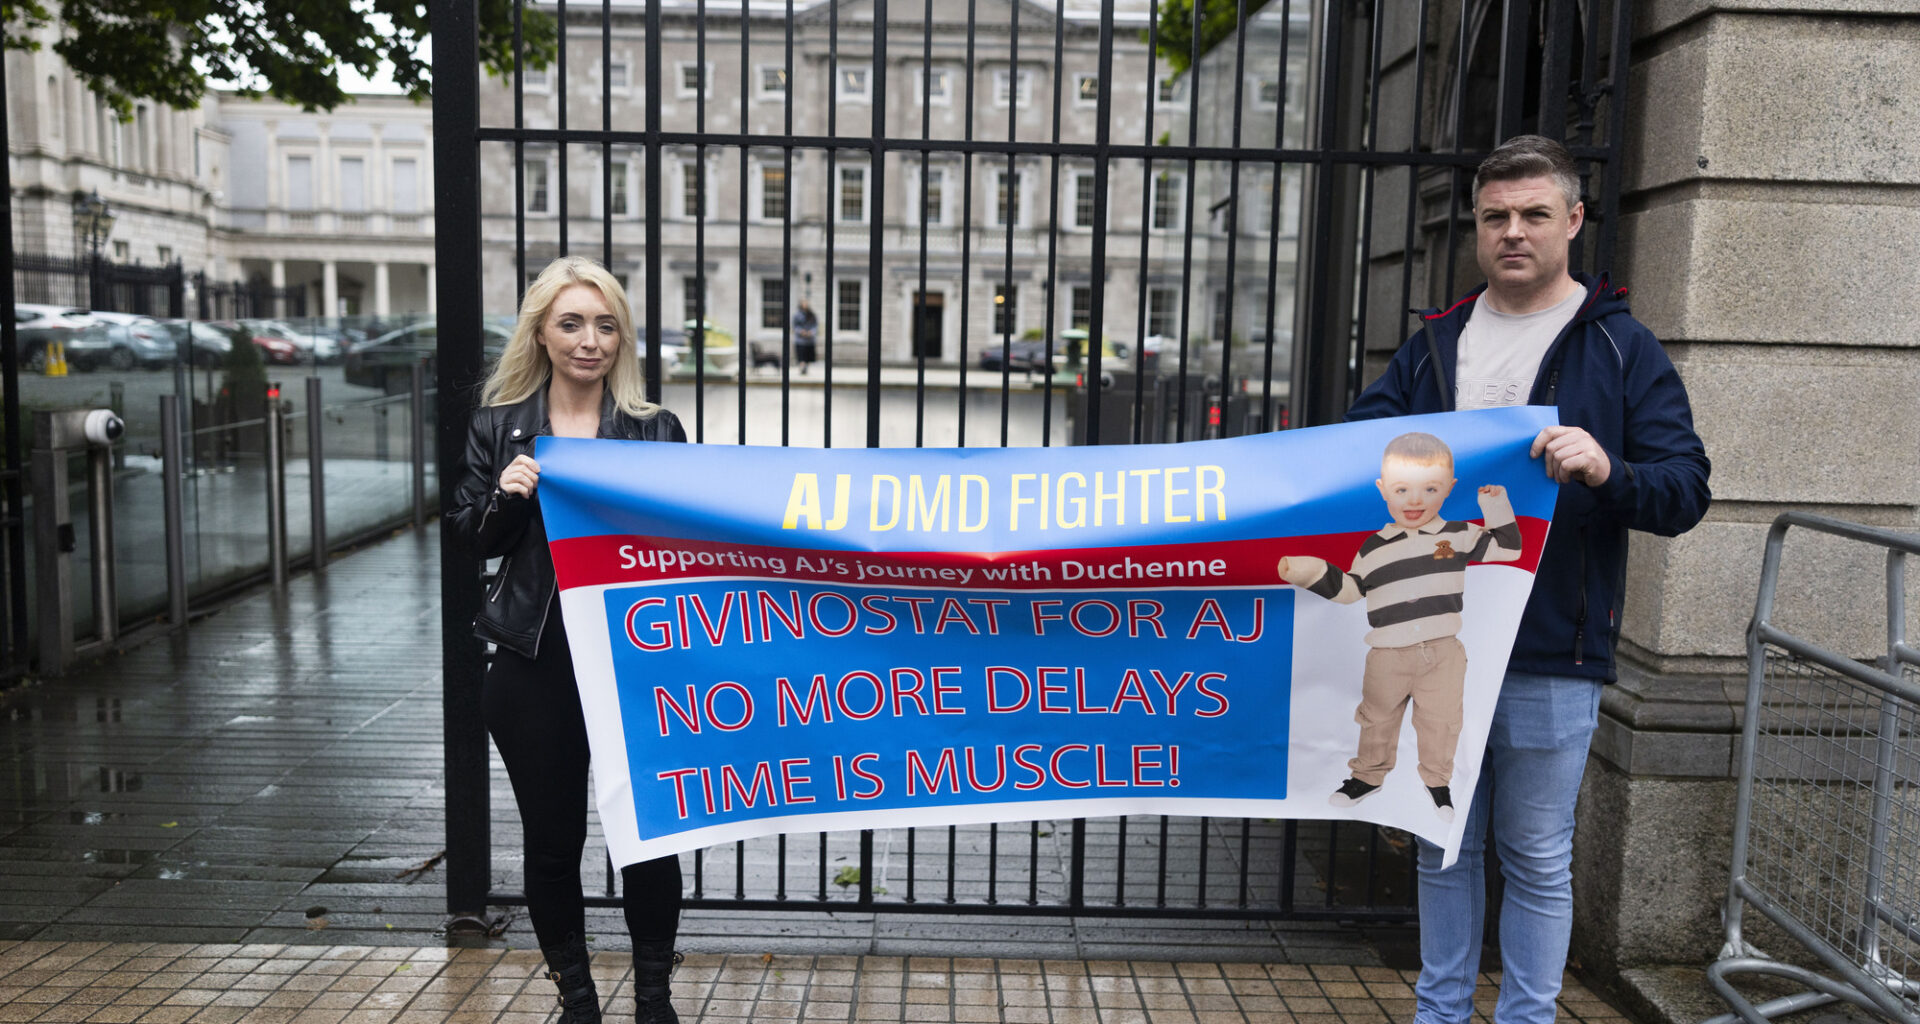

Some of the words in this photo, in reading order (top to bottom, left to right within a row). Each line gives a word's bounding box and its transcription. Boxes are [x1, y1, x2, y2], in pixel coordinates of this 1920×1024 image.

[782, 474, 851, 531] AJ
[870, 475, 989, 532] DMD
[1010, 465, 1227, 530] FIGHTER
[618, 545, 786, 575] Supporting
[856, 560, 972, 584] journey
[982, 562, 1052, 581] with
[1062, 557, 1227, 580] Duchenne
[625, 590, 1011, 652] GIVINOSTAT
[1032, 600, 1166, 638] FOR
[1187, 598, 1264, 643] AJ
[653, 682, 754, 736] NO
[776, 667, 965, 727] MORE
[986, 666, 1230, 718] DELAYS
[657, 758, 815, 819] TIME
[833, 754, 885, 800] IS
[906, 745, 1180, 796] MUSCLE!
